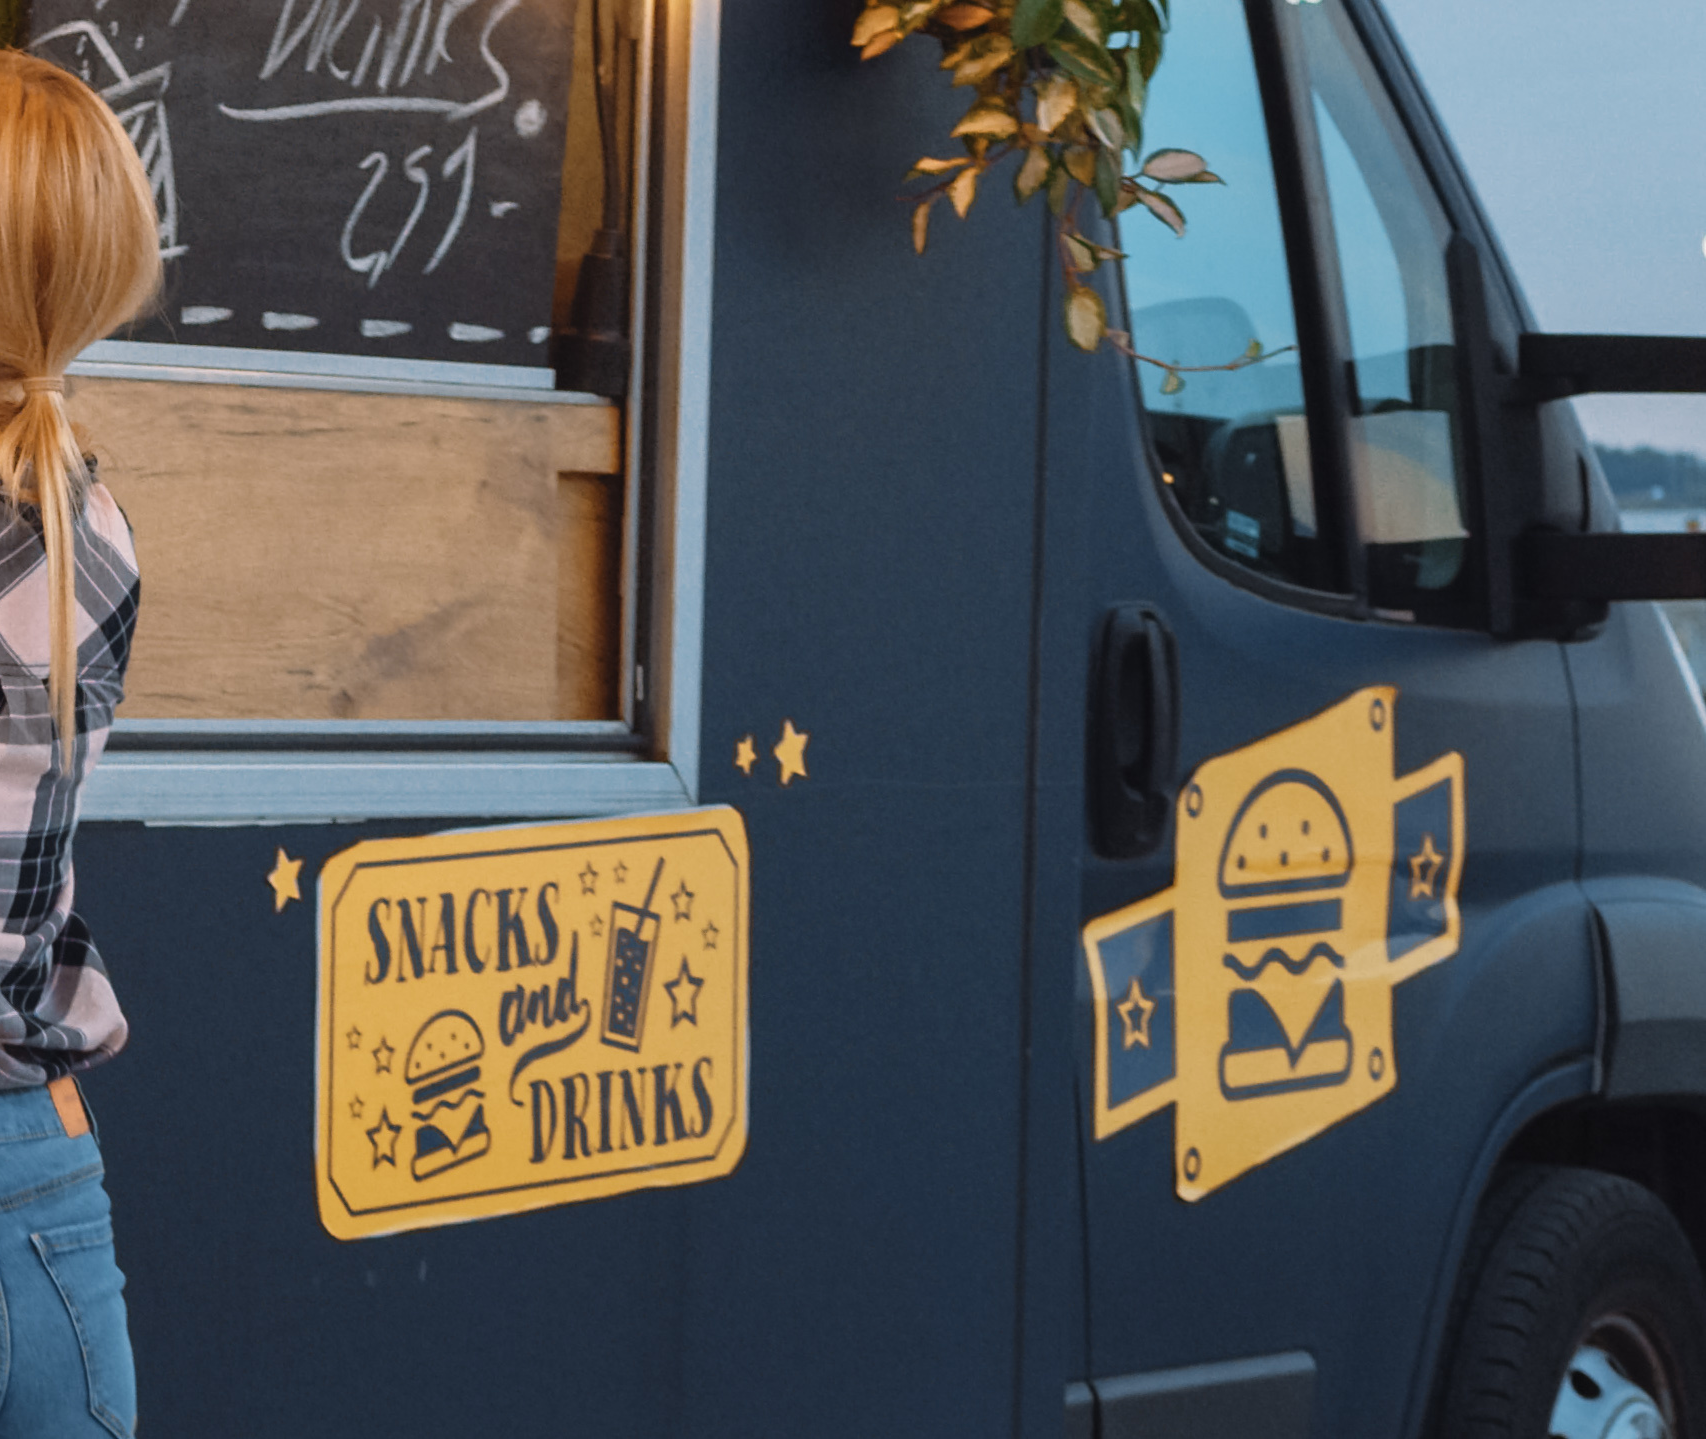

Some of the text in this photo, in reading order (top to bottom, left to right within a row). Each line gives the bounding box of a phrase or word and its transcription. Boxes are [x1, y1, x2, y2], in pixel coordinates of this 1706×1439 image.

[364, 881, 561, 986] SNACKS
[498, 929, 591, 1052] and
[528, 1056, 715, 1164] DRINKS
